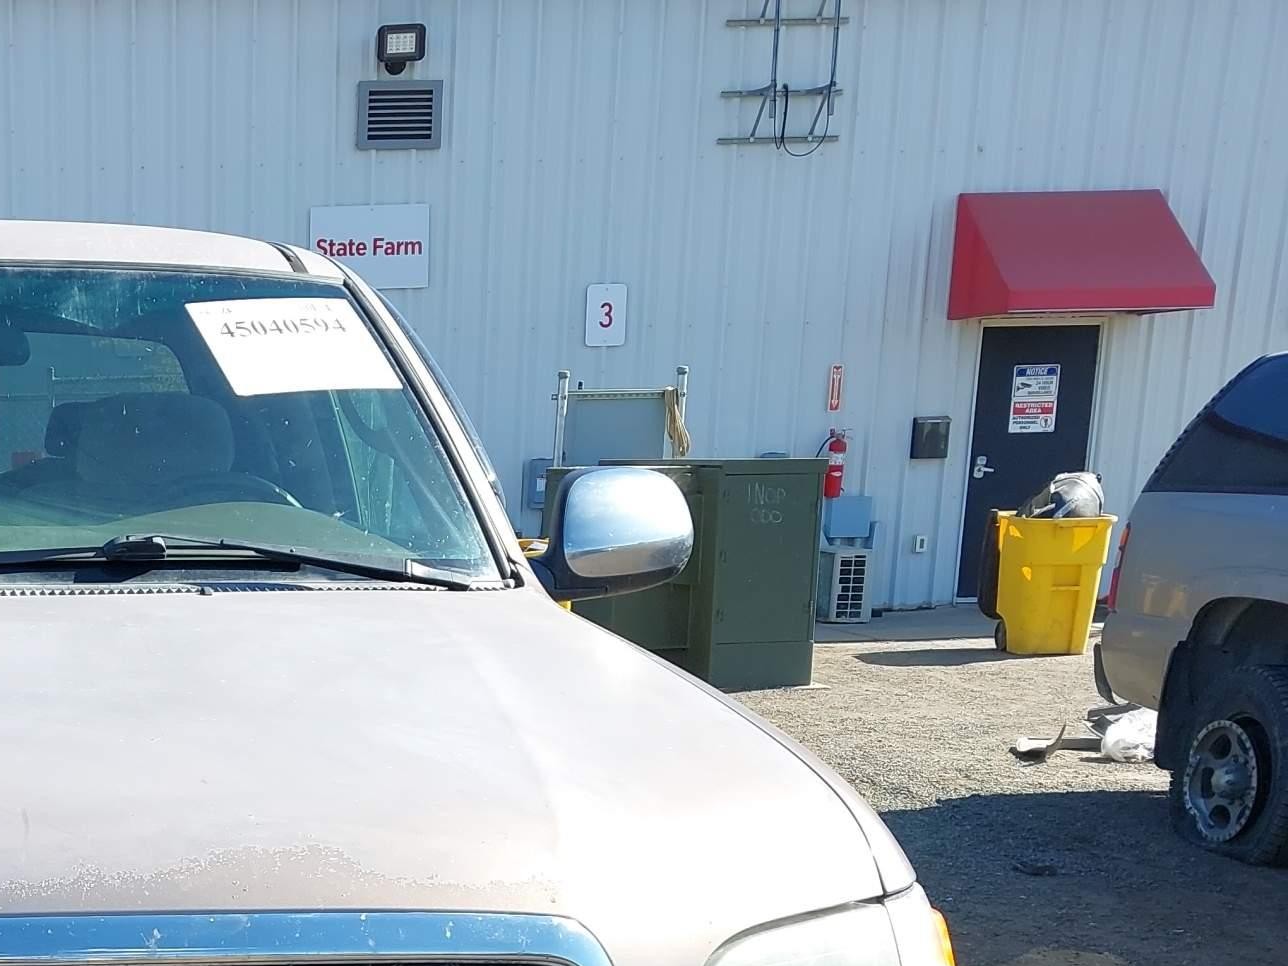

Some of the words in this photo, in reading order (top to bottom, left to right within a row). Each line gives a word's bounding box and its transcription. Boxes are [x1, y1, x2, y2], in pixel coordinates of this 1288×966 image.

[316, 238, 367, 257] State
[372, 237, 423, 256] Farm
[598, 302, 613, 328] 3
[220, 317, 347, 338] 45040594
[1026, 367, 1048, 376] NOTICE
